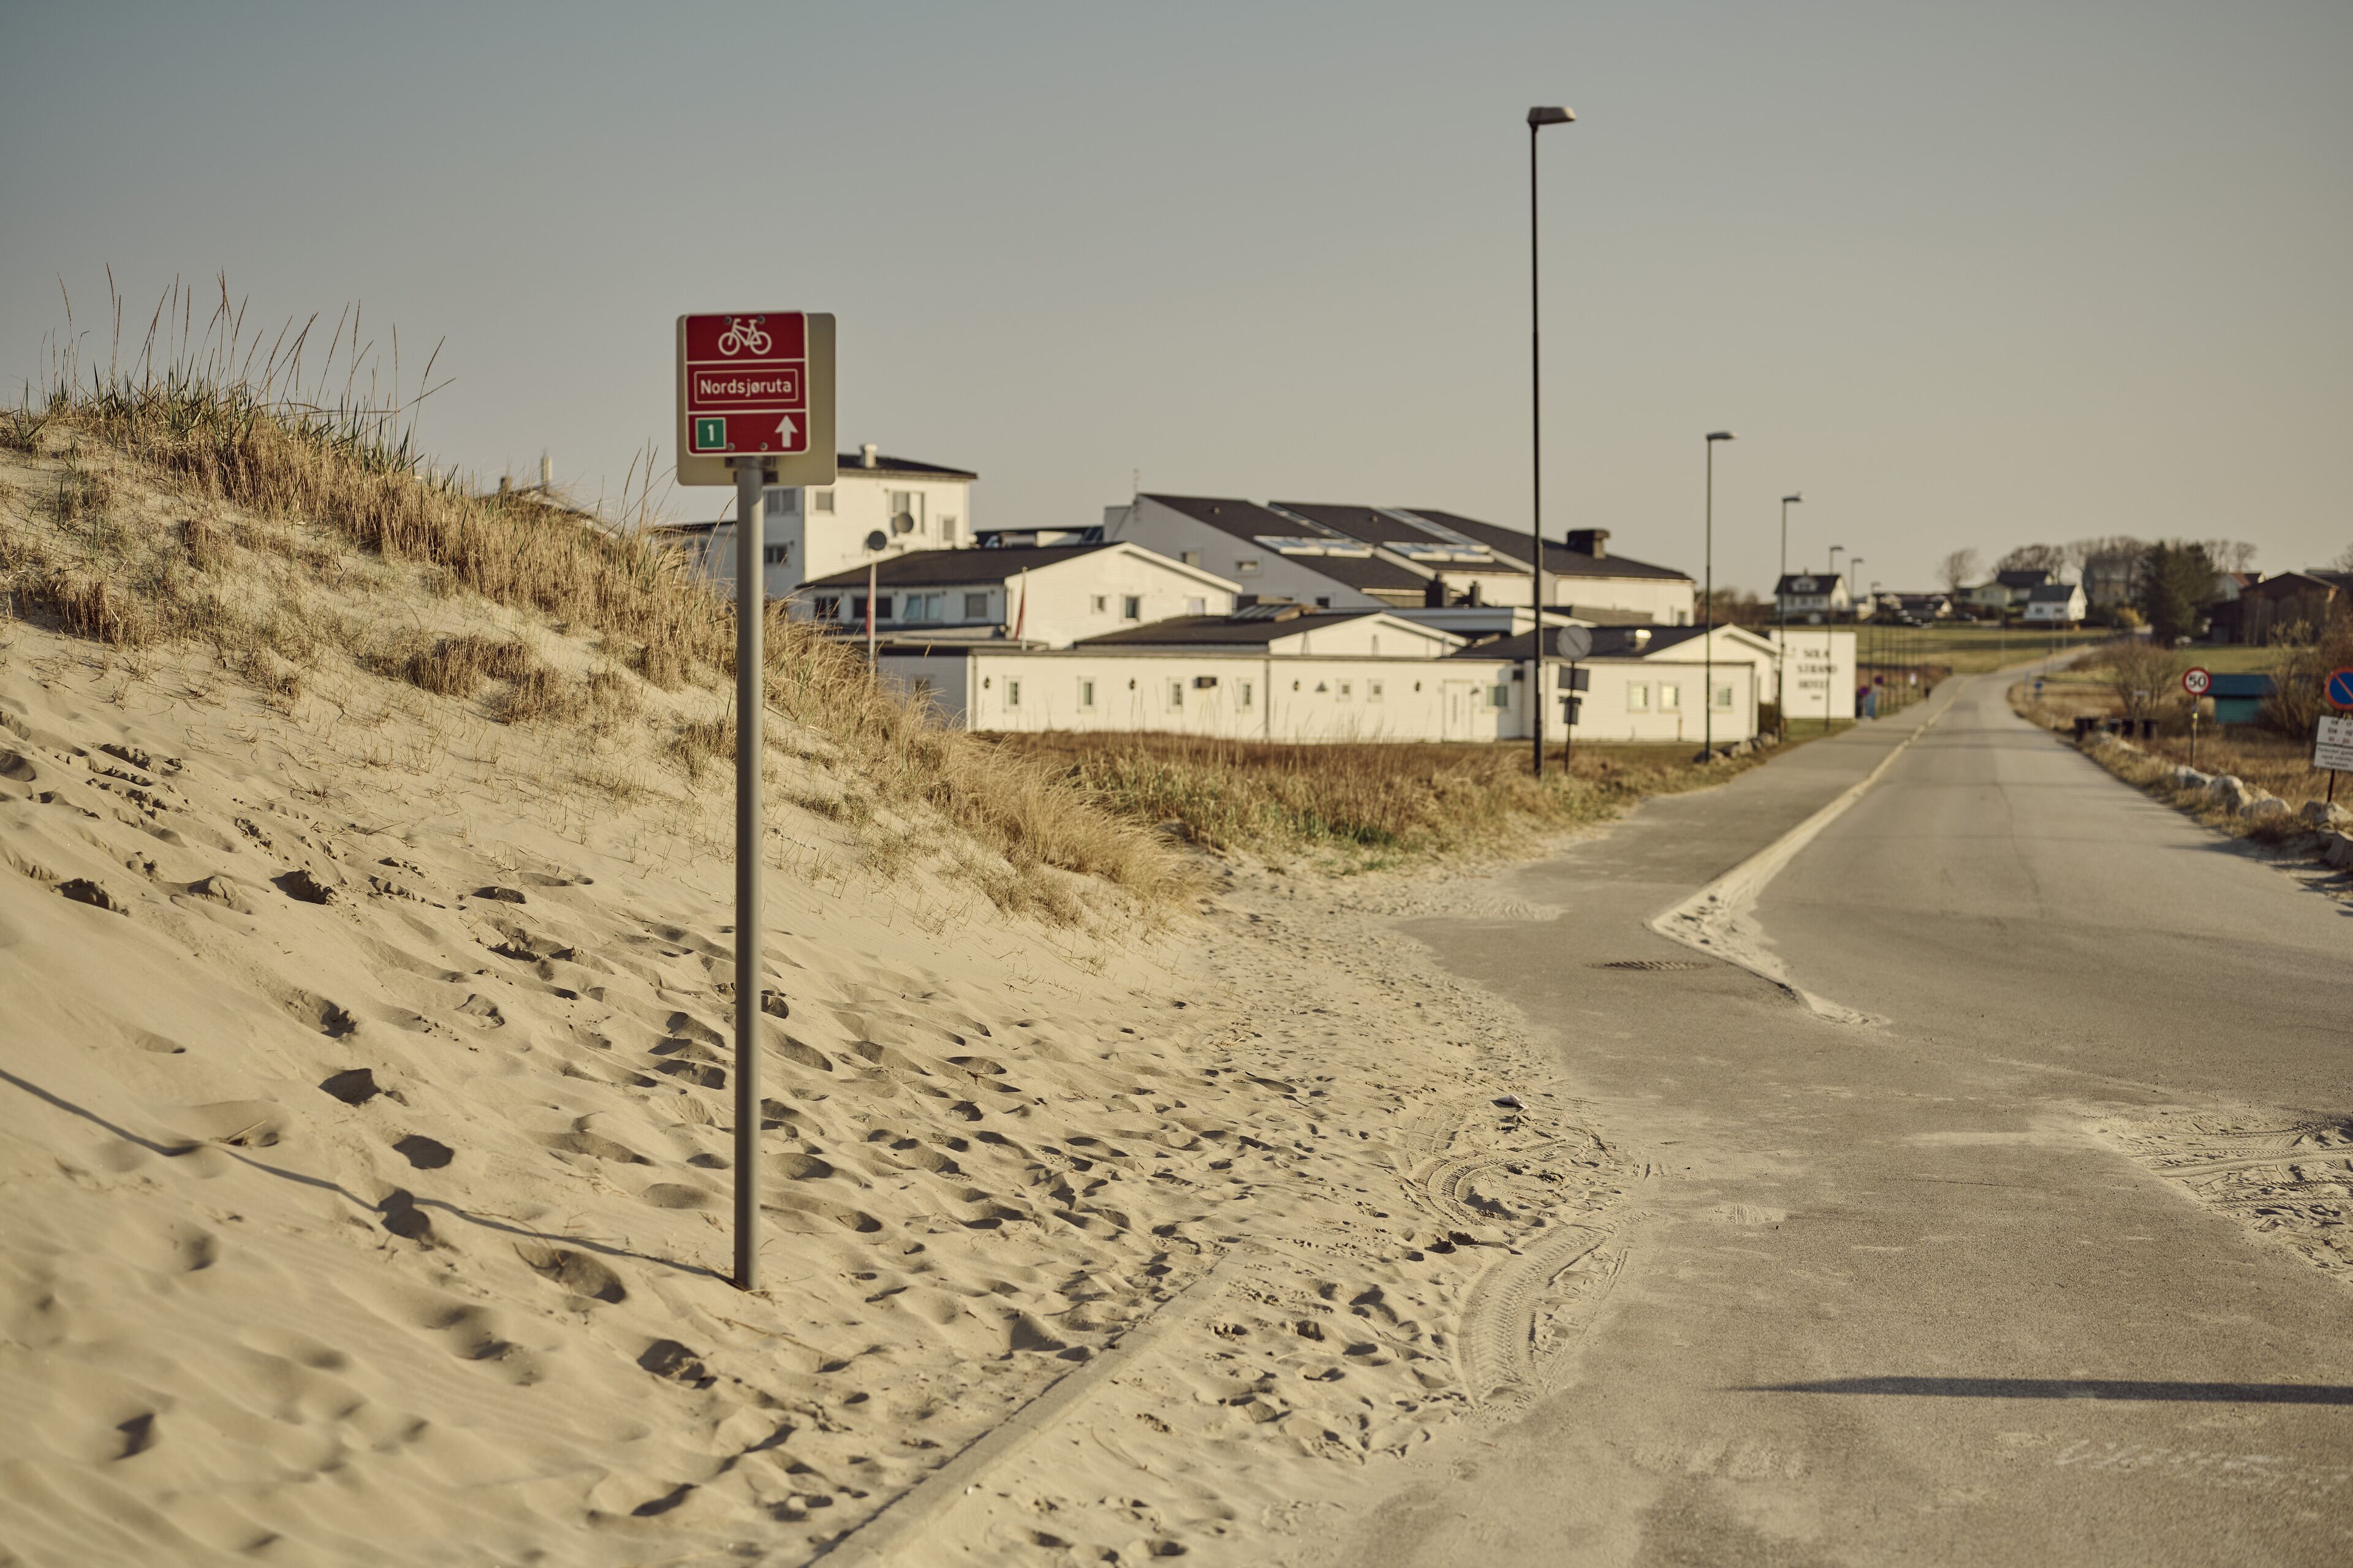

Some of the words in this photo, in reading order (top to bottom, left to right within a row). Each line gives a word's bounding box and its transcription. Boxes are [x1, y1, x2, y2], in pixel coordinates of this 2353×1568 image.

[700, 378, 792, 398] Nordsjøruta
[707, 423, 715, 442] 1
[2188, 675, 2207, 688] 50
